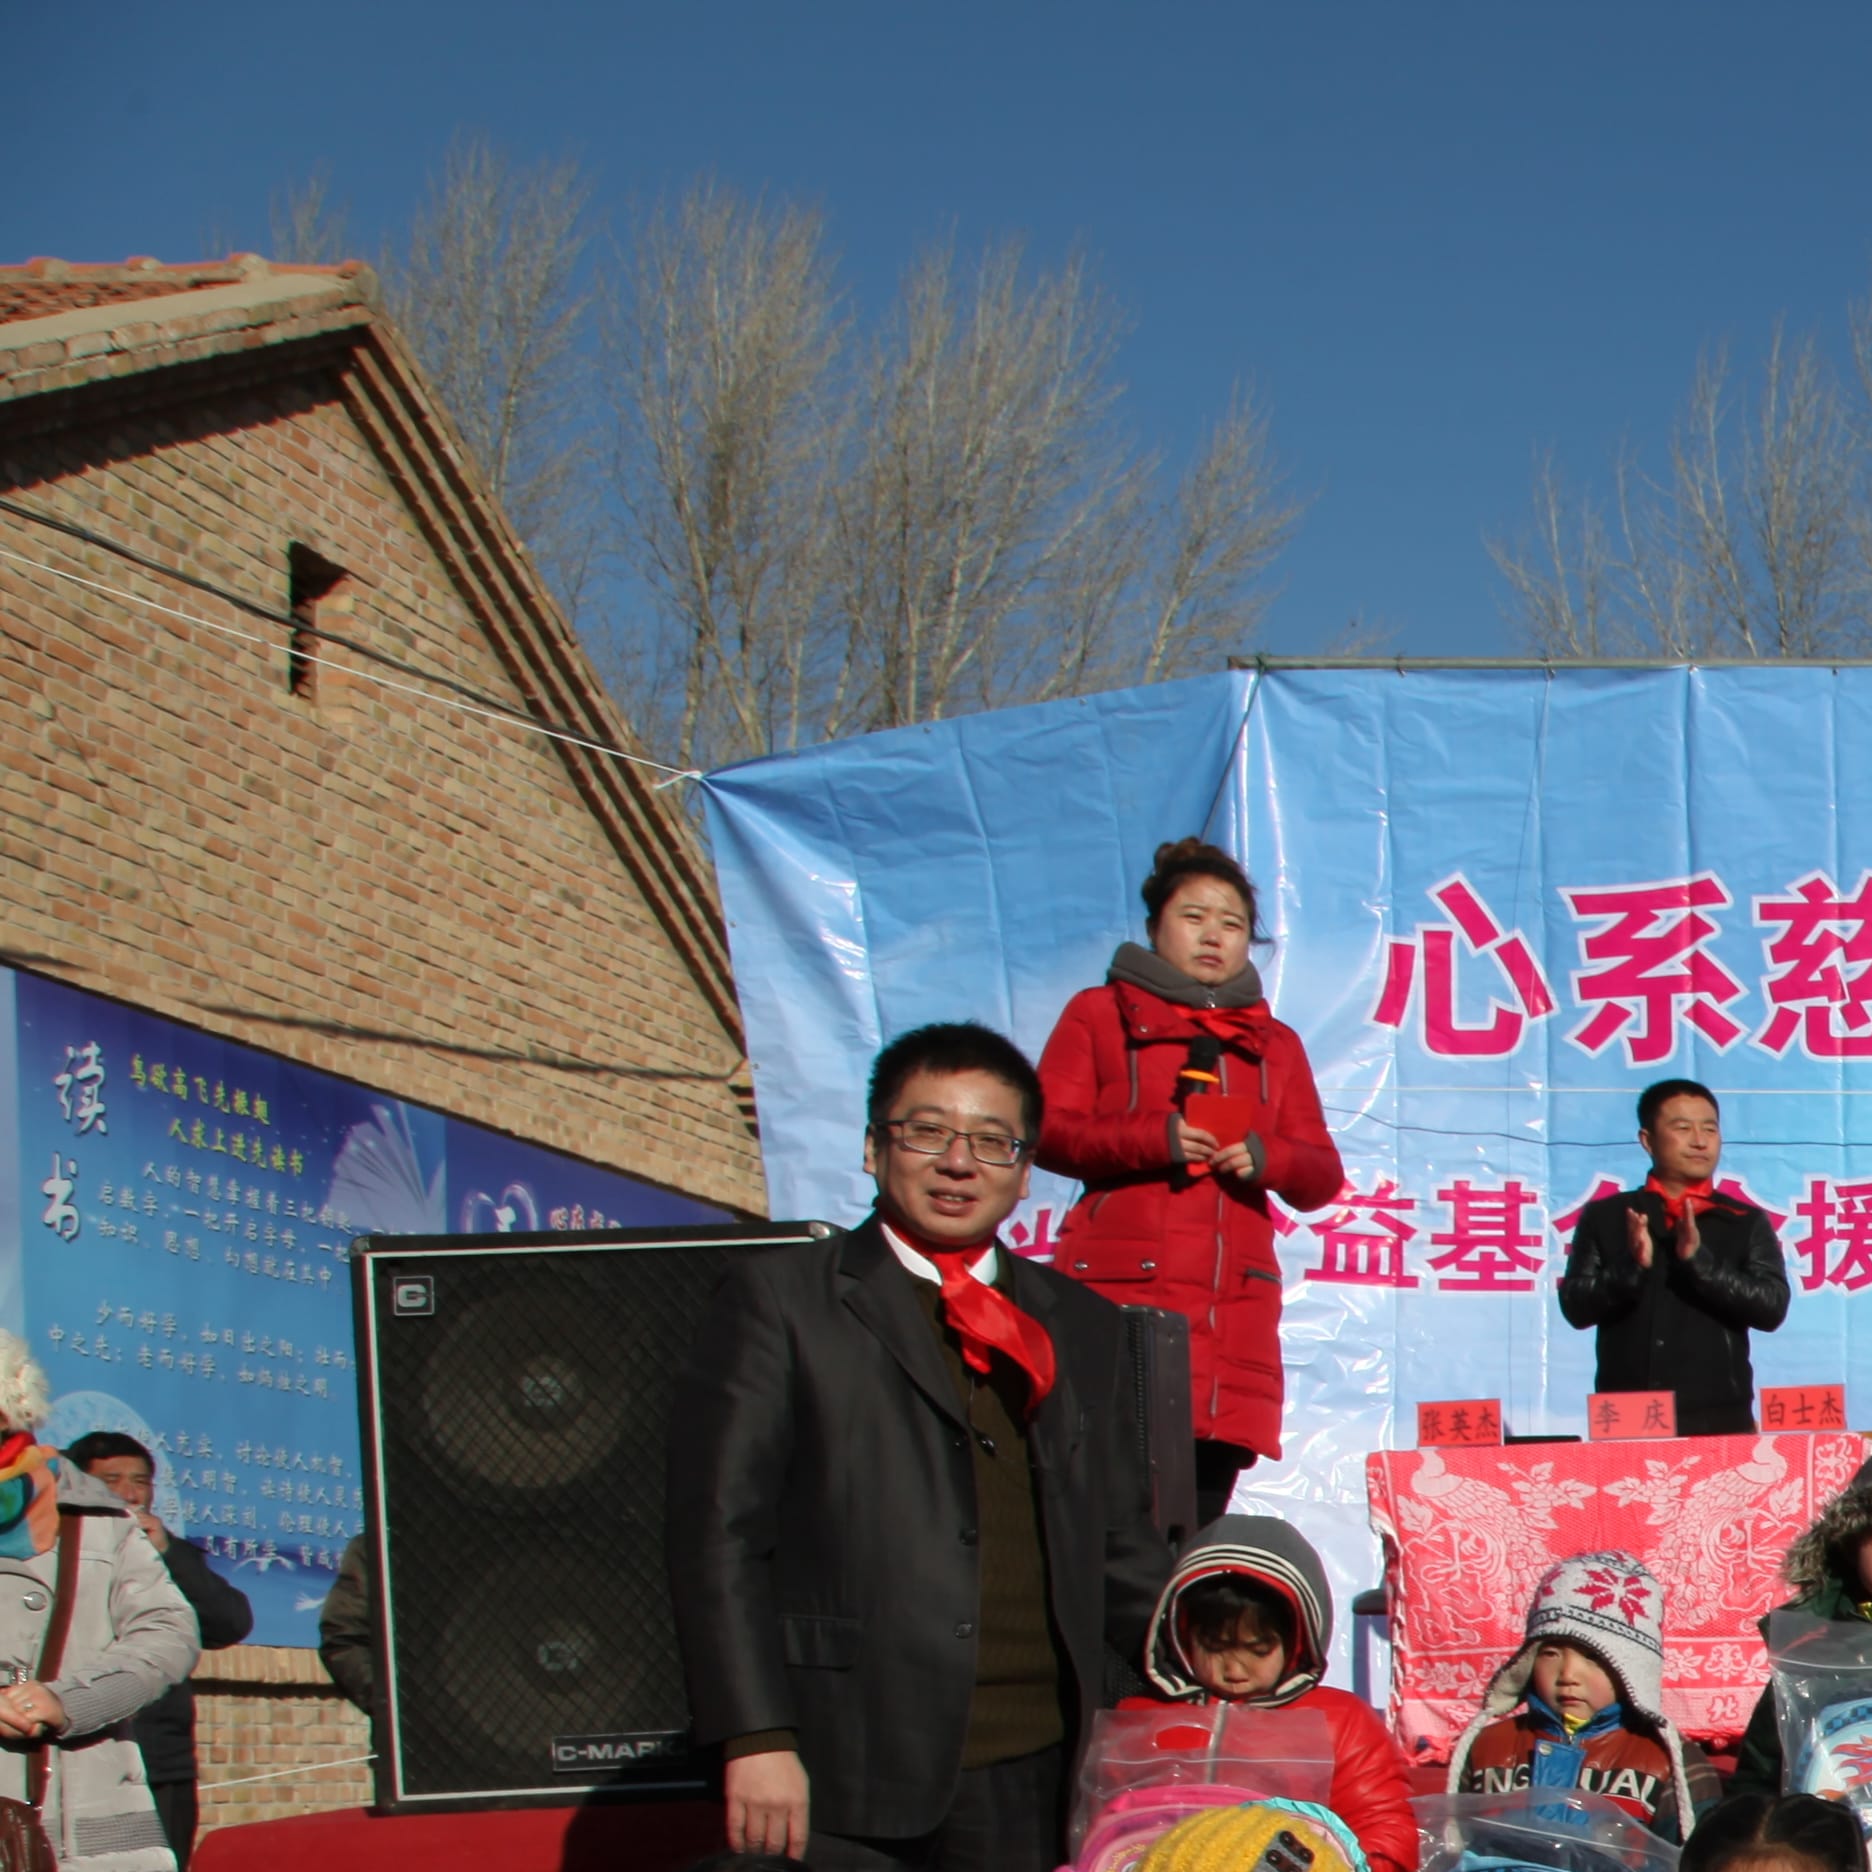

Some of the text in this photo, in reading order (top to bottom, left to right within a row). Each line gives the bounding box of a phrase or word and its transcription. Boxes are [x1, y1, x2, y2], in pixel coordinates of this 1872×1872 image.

[1765, 1391, 1844, 1428] 白士杰
[556, 1741, 668, 1762] C-MAR
